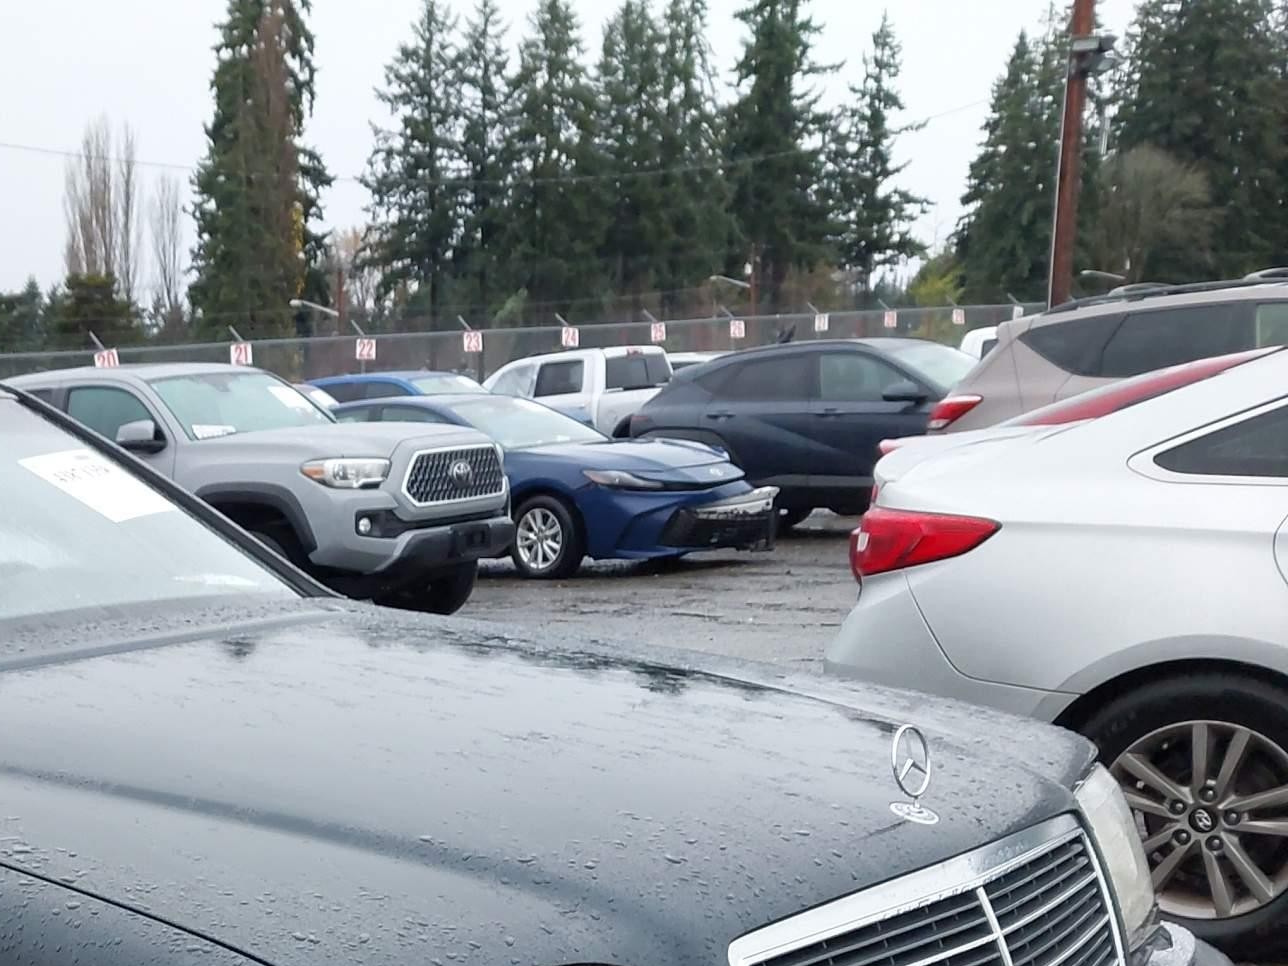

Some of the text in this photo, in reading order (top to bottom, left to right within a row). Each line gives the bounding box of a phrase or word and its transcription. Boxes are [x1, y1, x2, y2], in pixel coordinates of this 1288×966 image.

[466, 333, 481, 351] 23
[564, 328, 578, 345] 24
[234, 345, 248, 366] 21
[359, 340, 374, 358] 22
[97, 352, 116, 368] 20
